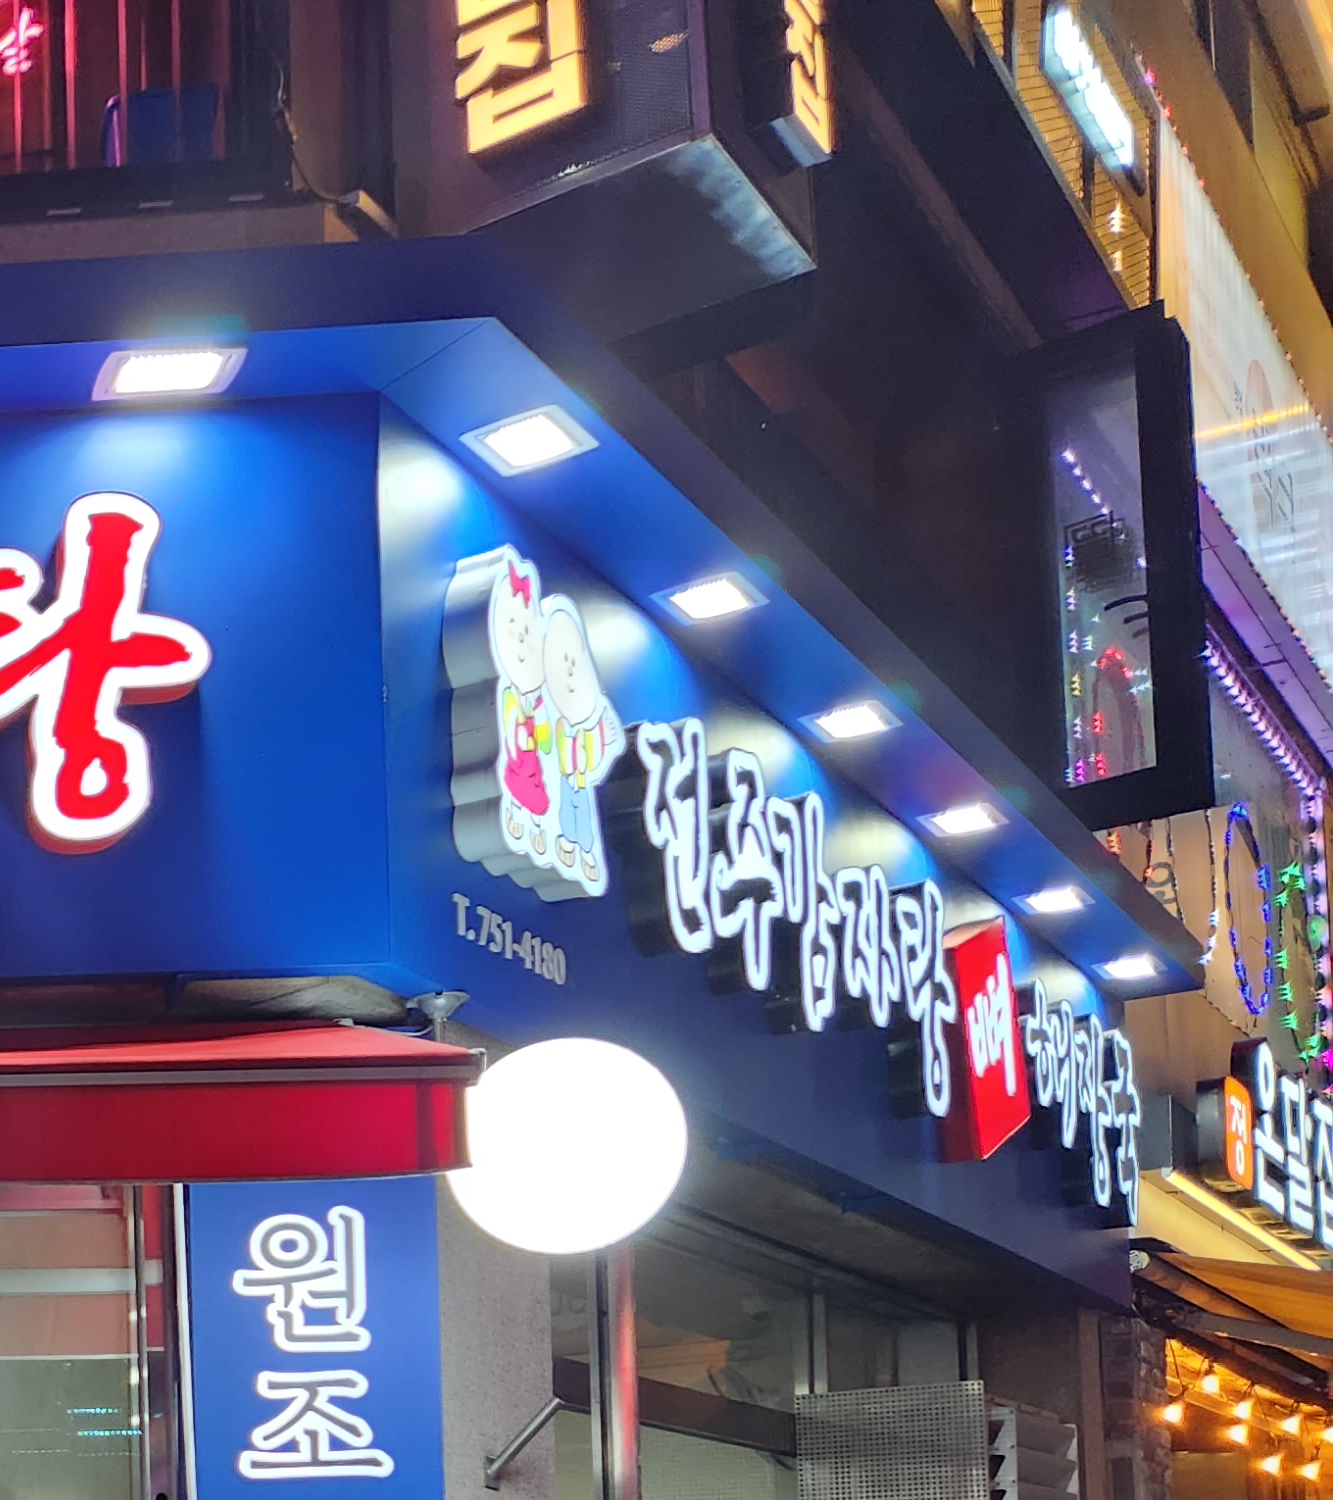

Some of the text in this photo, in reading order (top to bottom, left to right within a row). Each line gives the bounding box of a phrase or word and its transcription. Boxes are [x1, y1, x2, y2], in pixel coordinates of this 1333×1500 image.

[455, 0, 585, 154] 집
[638, 716, 1141, 1228] 전주감자탕 뼈 해장국
[232, 1206, 395, 1478] 원조
